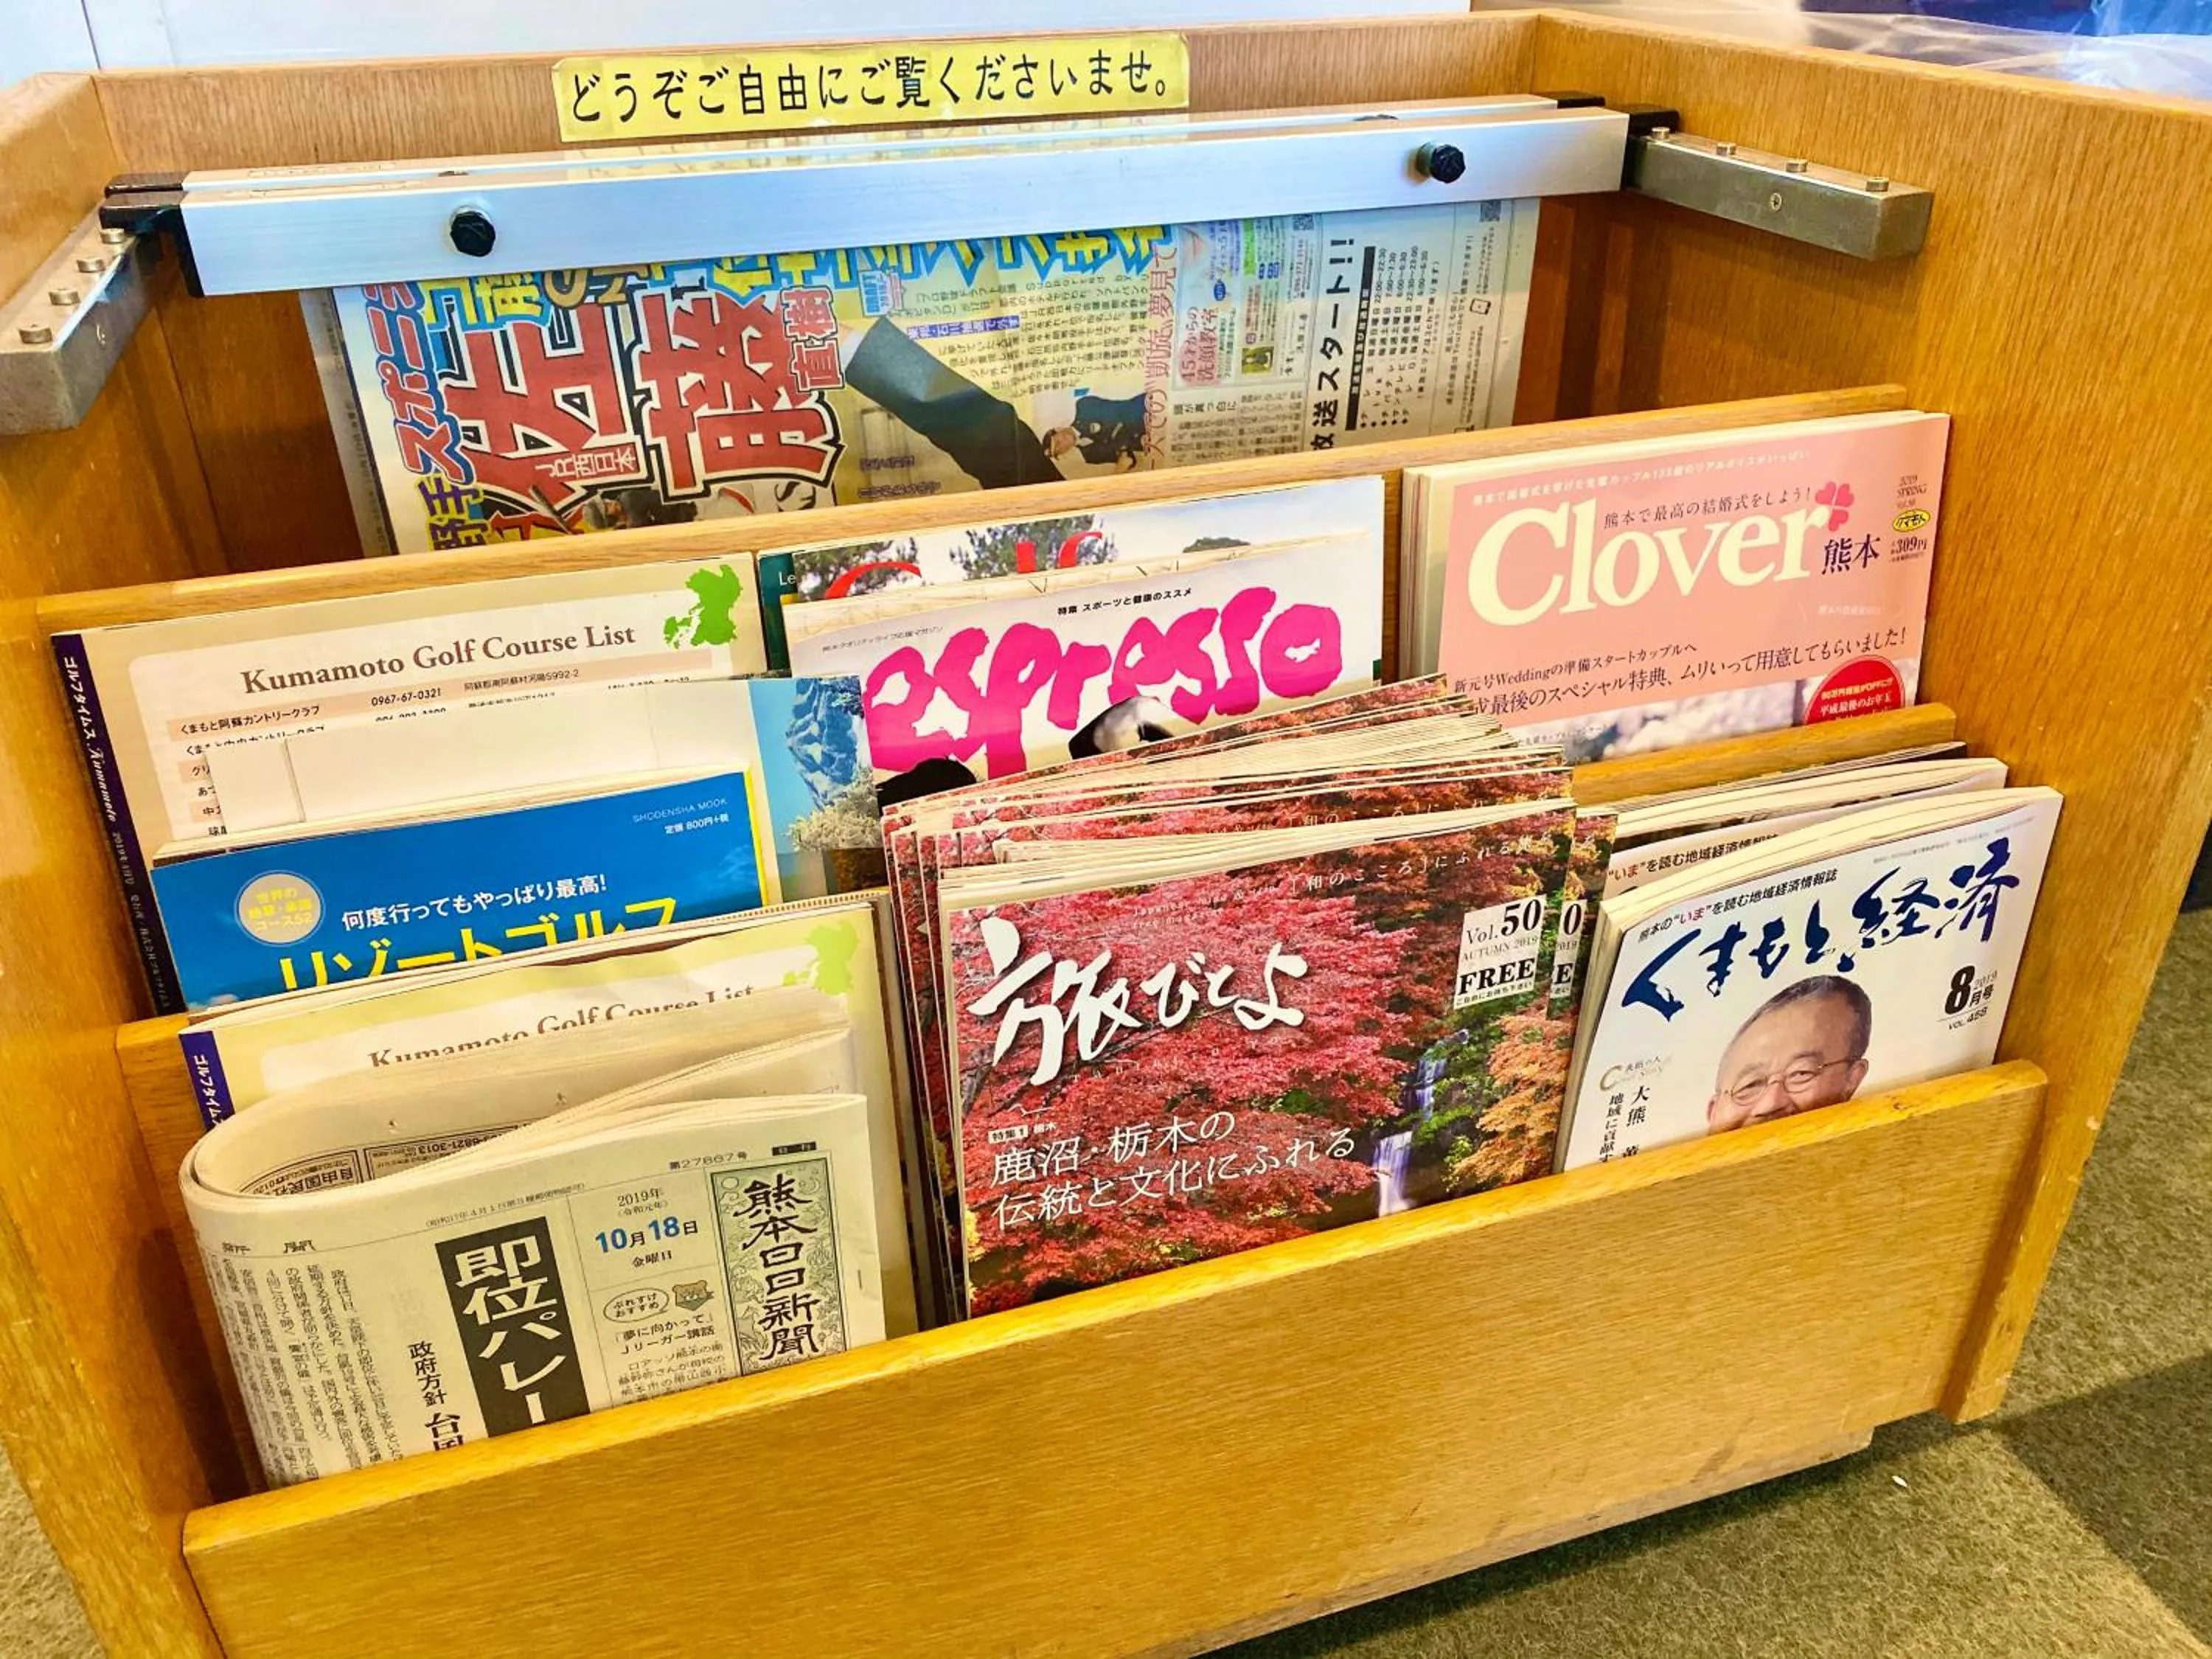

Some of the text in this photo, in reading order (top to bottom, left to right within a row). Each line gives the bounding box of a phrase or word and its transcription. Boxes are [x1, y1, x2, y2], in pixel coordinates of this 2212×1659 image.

[572, 49, 1167, 123] どうぞご自由にご覧くださいませ。
[441, 291, 829, 510] 佐藤
[535, 445, 636, 481] JR西日本
[1467, 496, 1834, 627] Clover
[1821, 533, 1881, 575] 熊本
[240, 625, 637, 695] Kumamoto Golf Course List
[862, 586, 1343, 782] espresso
[64, 655, 97, 740] ゴルフタイムス
[371, 688, 442, 708] 0967-67-0321
[698, 797, 728, 813] MOOK
[341, 874, 608, 933] 何度行ってもやっぱり最高!
[1621, 836, 2020, 1023] くまもと経済
[967, 915, 1309, 1088] 旅びとよ
[1458, 958, 1535, 996] FREE
[990, 1111, 1236, 1189] 鹿沼・栃木の
[991, 1124, 1357, 1231] 伝統と文化にふれる
[617, 1187, 663, 1208] 2019年
[594, 1216, 698, 1253] 10月18日
[632, 1249, 673, 1269] 金曜日
[734, 1173, 820, 1361] 熊本日日新聞
[453, 1234, 566, 1425] 即位パレー
[616, 1301, 660, 1318] おすすめ
[616, 1312, 713, 1343] 「夢に向かって」
[408, 1340, 447, 1407] 政府方針
